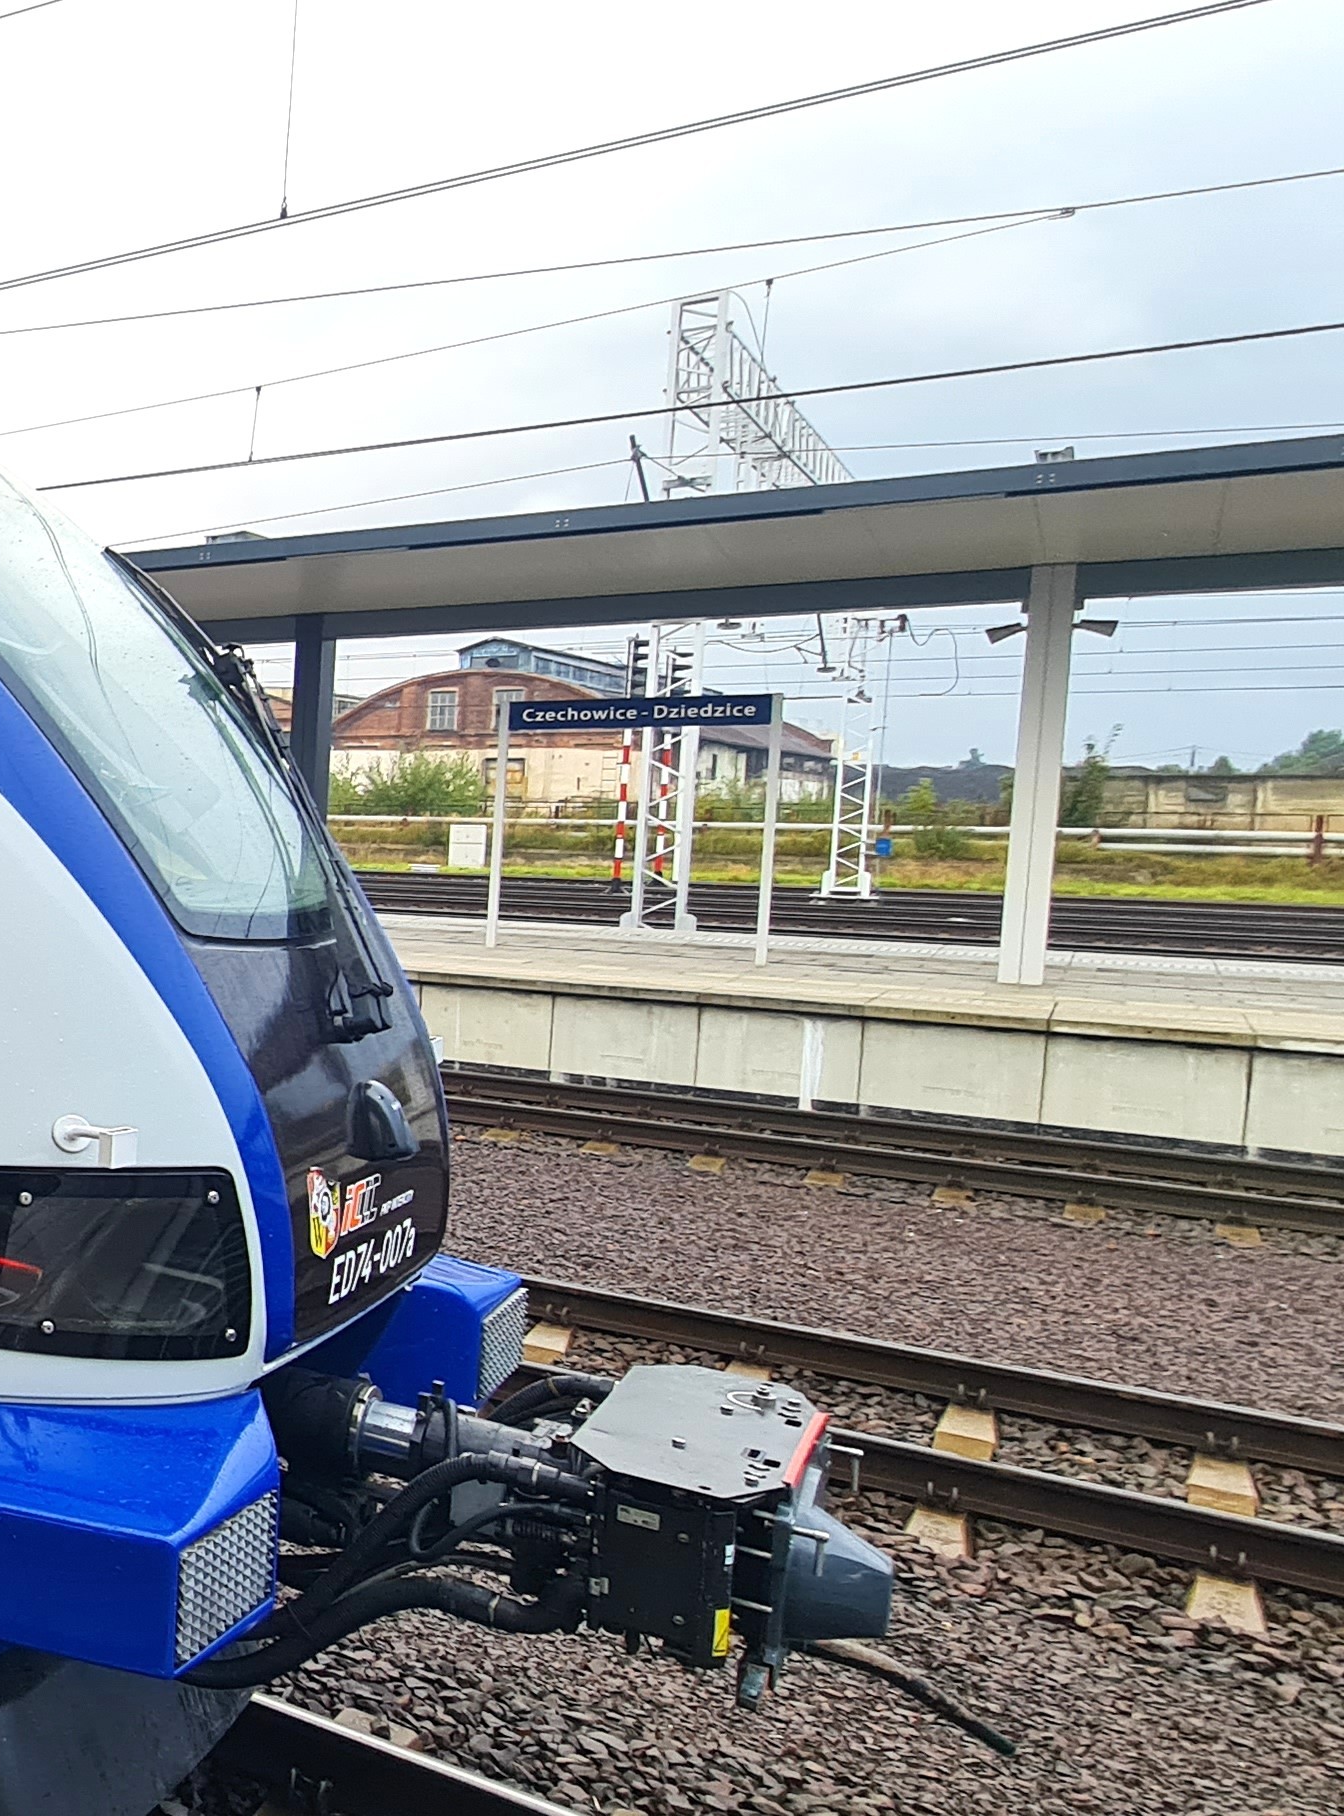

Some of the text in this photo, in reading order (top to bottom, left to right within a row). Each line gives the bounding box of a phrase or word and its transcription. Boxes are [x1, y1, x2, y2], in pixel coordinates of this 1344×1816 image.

[522, 706, 637, 722] Czechowice
[653, 703, 756, 718] Dziedzice
[328, 1217, 416, 1305] ED74-007a
